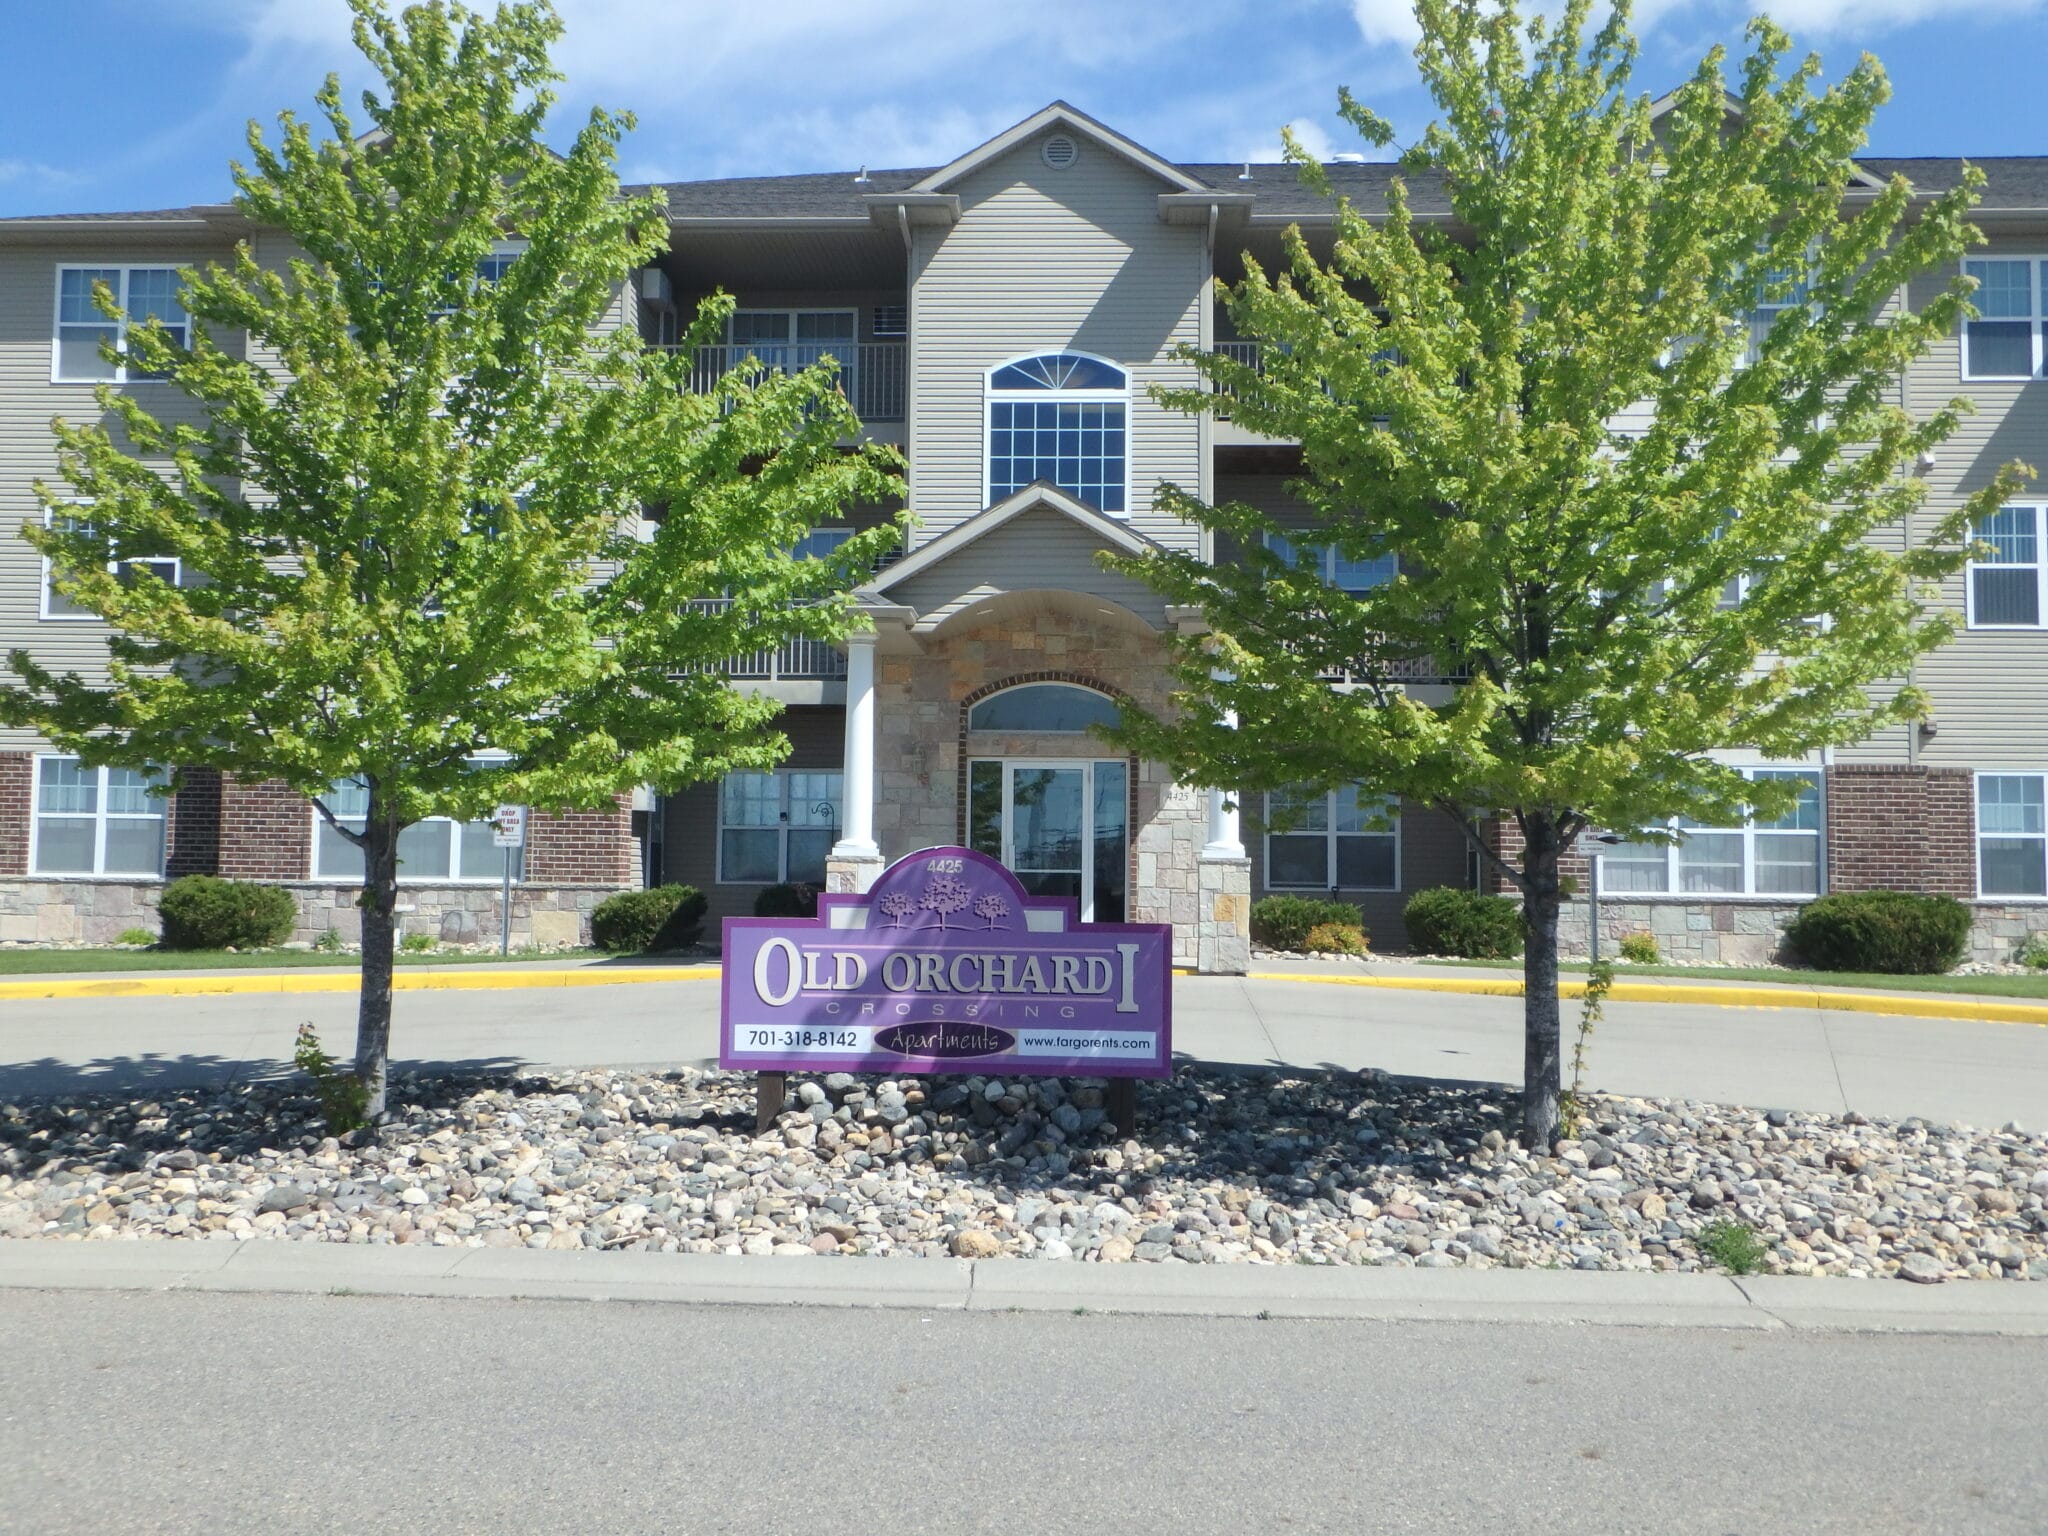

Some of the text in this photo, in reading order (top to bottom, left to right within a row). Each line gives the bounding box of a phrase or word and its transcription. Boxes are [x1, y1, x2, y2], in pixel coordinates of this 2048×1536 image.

[1167, 792, 1189, 801] 4425
[926, 859, 964, 874] 4425
[753, 937, 1139, 1012] OLD ORCHARD I
[825, 1002, 1075, 1018] CROSSING
[749, 1030, 857, 1047] 701-318-8142
[890, 1024, 999, 1059] Apartments
[1024, 1036, 1150, 1050] www.fargorents.com
